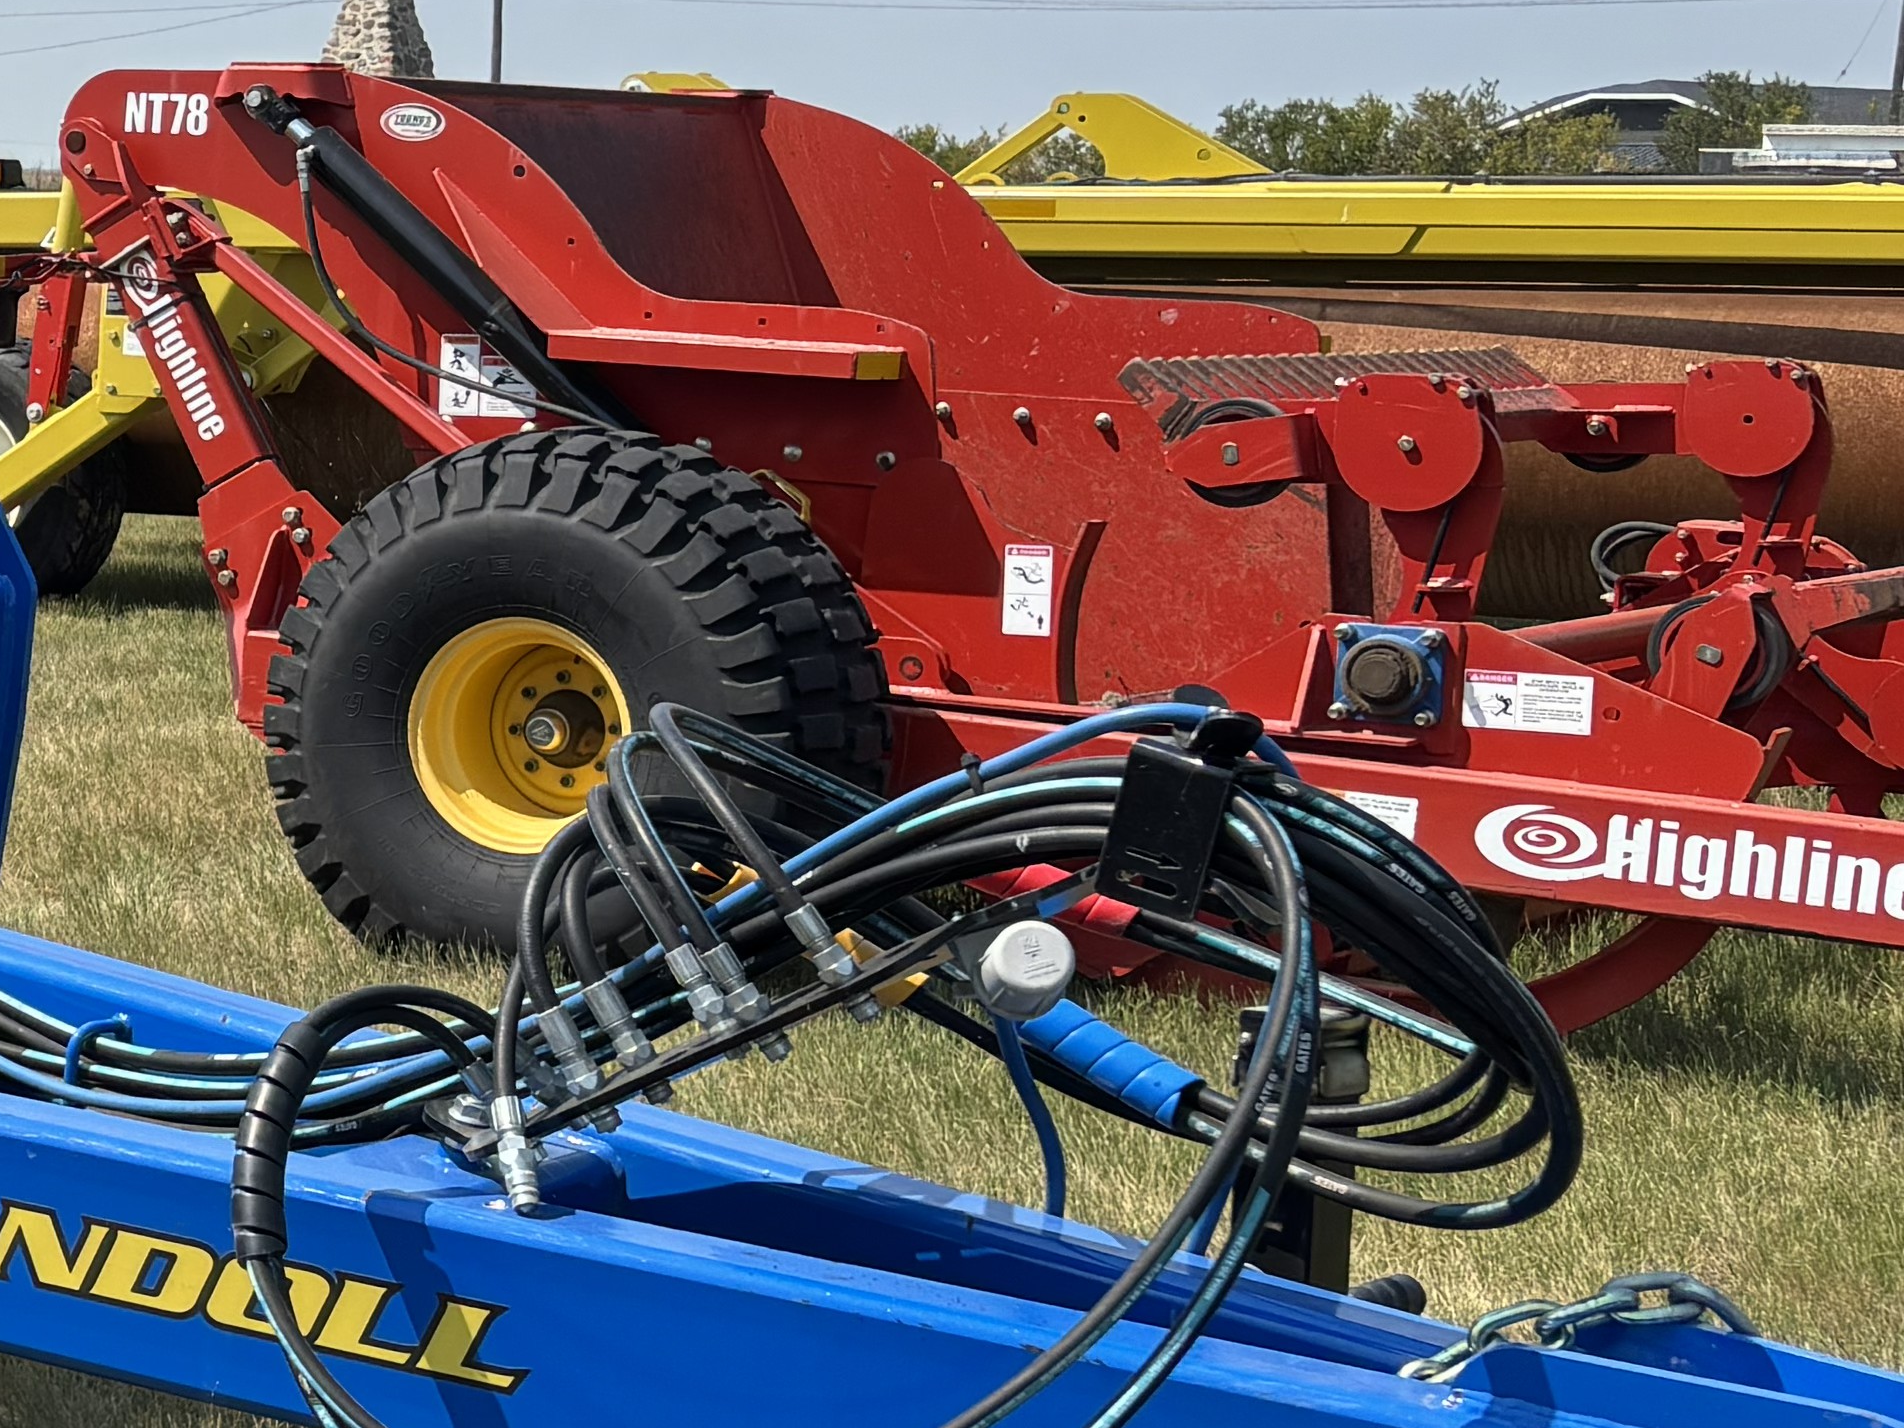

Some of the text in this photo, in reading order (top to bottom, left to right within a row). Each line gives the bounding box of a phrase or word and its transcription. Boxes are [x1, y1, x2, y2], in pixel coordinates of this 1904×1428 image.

[123, 91, 209, 136] NT78
[1385, 862, 1427, 895] GATES
[1295, 1029, 1313, 1074] GATES
